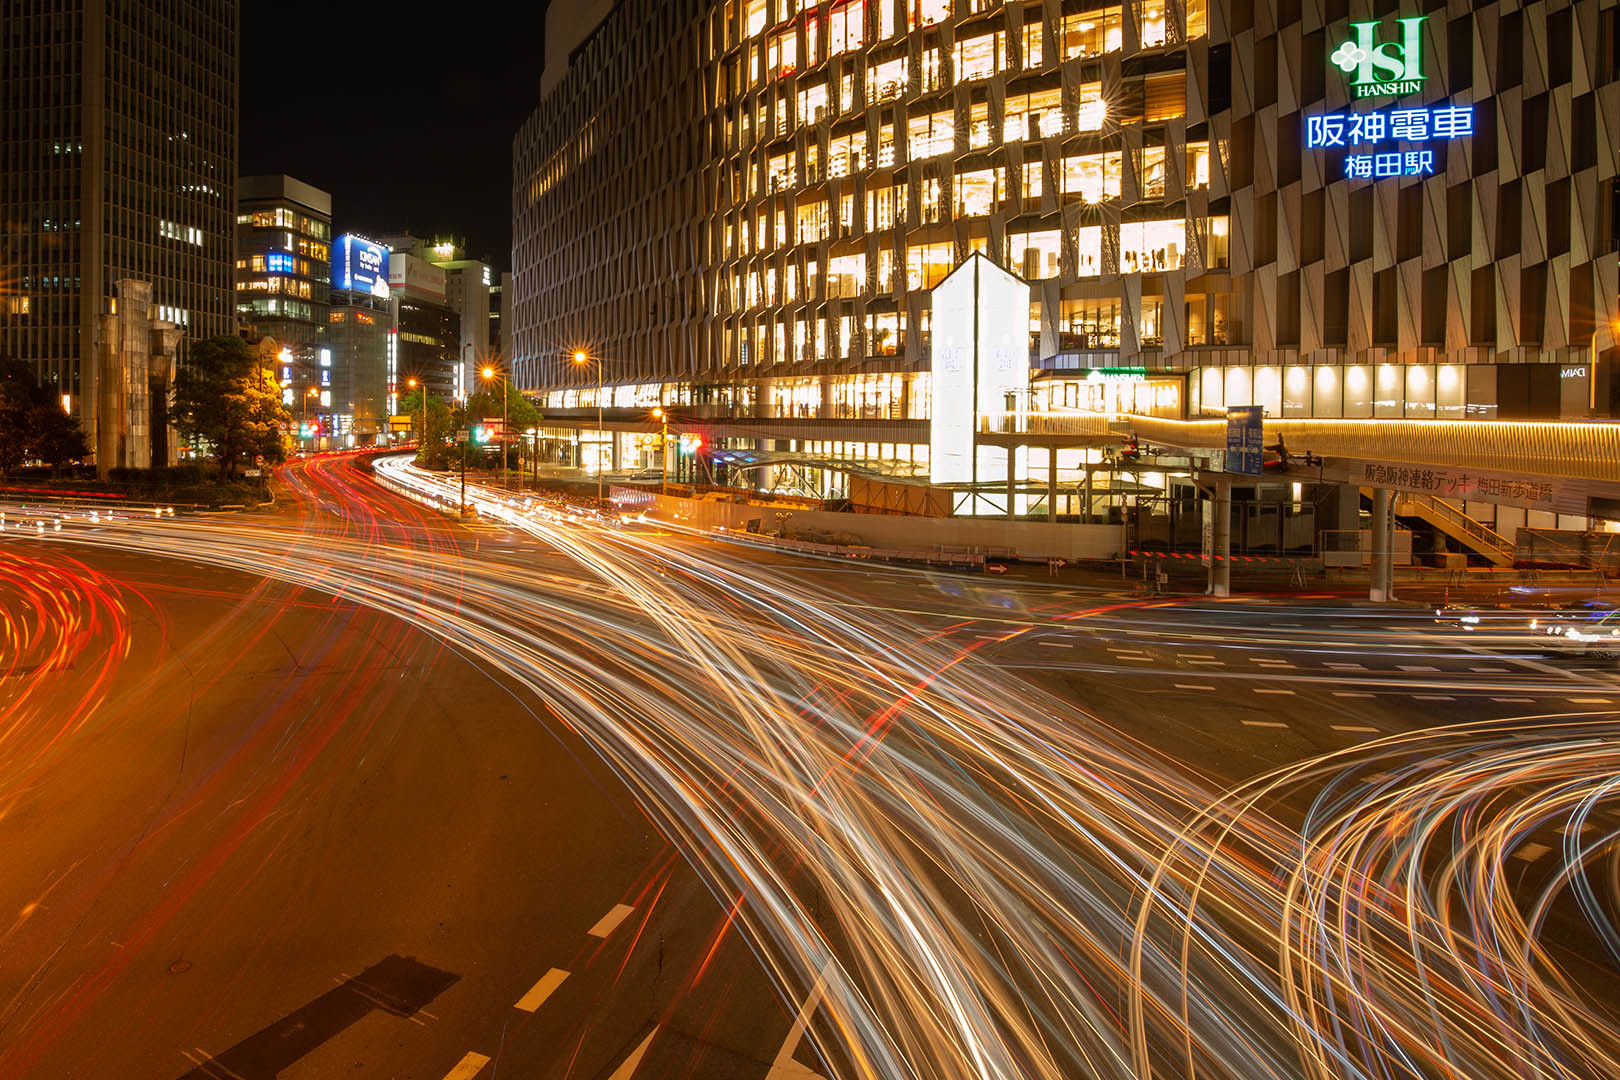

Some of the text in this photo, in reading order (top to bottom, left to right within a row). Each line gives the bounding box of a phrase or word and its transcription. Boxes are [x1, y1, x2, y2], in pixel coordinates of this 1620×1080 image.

[1357, 81, 1421, 97] HANSHIN
[1307, 106, 1473, 148] 阪神電車
[1345, 150, 1433, 179] 梅田駅
[1365, 463, 1553, 503] 阪急阪神連絡デッキ 梅田新歩道橋
